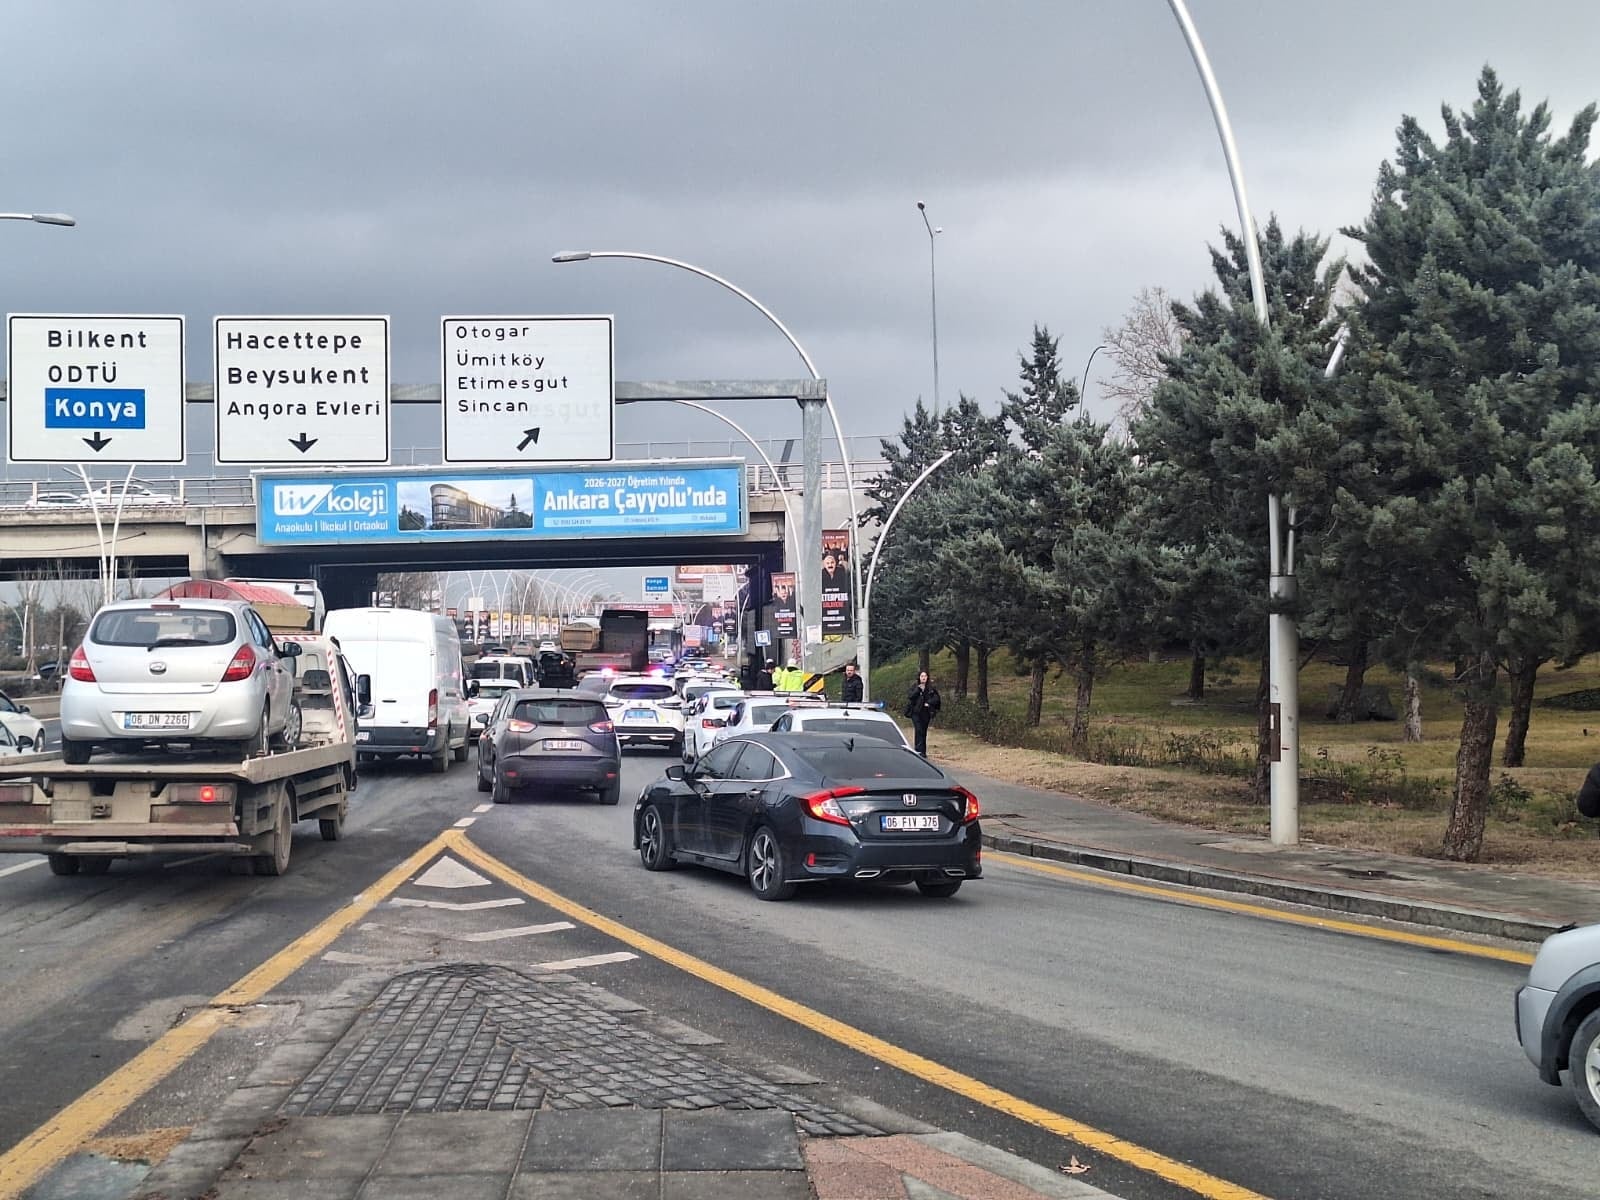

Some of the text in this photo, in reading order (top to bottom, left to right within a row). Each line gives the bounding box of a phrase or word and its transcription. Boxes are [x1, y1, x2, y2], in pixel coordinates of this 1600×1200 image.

[48, 330, 147, 348] Bilkent
[456, 325, 529, 341] Otogar
[227, 332, 362, 354] Hacettepe
[457, 349, 545, 370] Ümitköy
[48, 361, 117, 383] ODTÜ
[227, 366, 369, 388] Beysukent
[458, 376, 568, 392] Etimesgut
[55, 399, 137, 422] Konya
[227, 400, 380, 420] Angora Evleri
[458, 399, 529, 413] Sincan
[584, 476, 626, 488] 2026-2027
[627, 475, 658, 489] Öğretim
[327, 489, 384, 517] koleji
[543, 485, 727, 514] Ankara Çayyolu'nda
[275, 521, 313, 533] Anaokulu
[354, 519, 388, 531] Ortaokul
[131, 714, 187, 725] 06 DN 2266
[887, 817, 937, 828] 06 FIV 376
